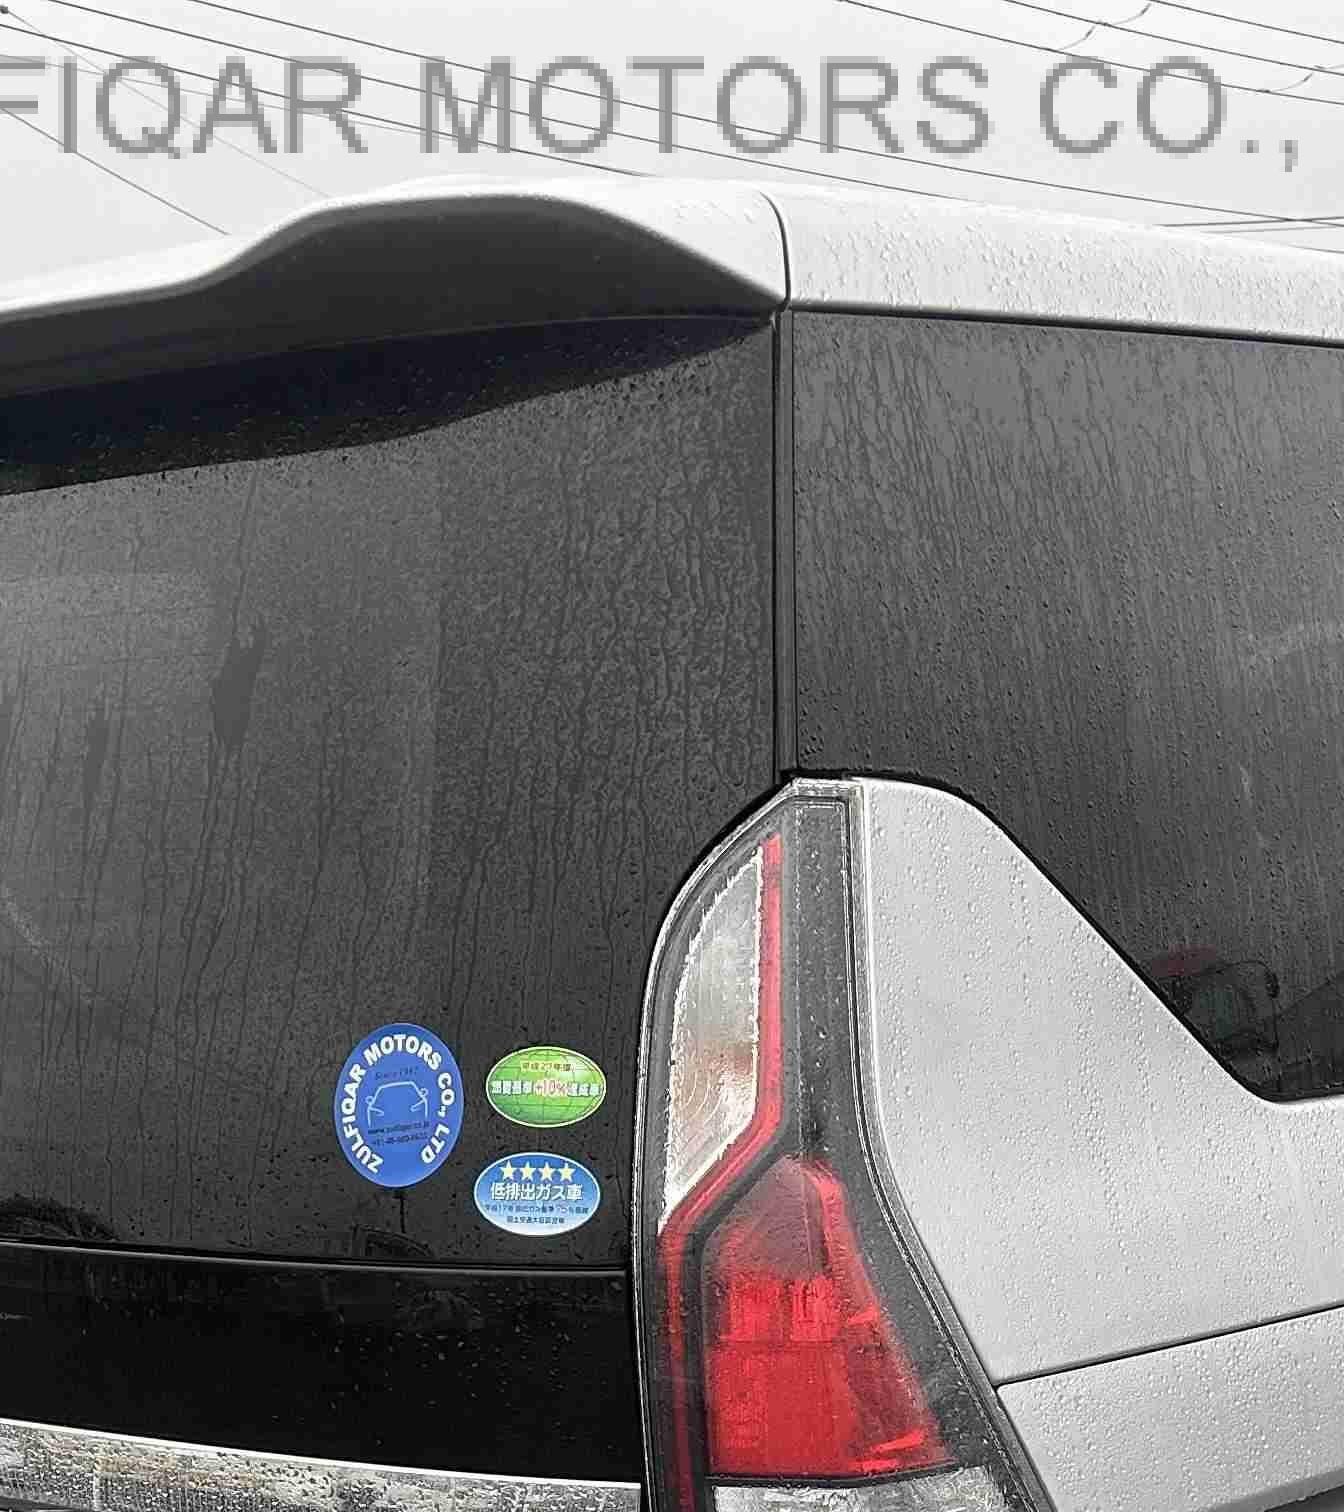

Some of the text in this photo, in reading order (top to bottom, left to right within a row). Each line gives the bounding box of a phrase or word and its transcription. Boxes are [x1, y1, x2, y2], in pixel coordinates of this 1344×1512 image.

[341, 1064, 384, 1174] ZULFIQAR
[363, 1034, 442, 1071] MOTORS
[421, 1124, 450, 1164] LTD
[490, 1182, 583, 1201] 低排出ガス車
